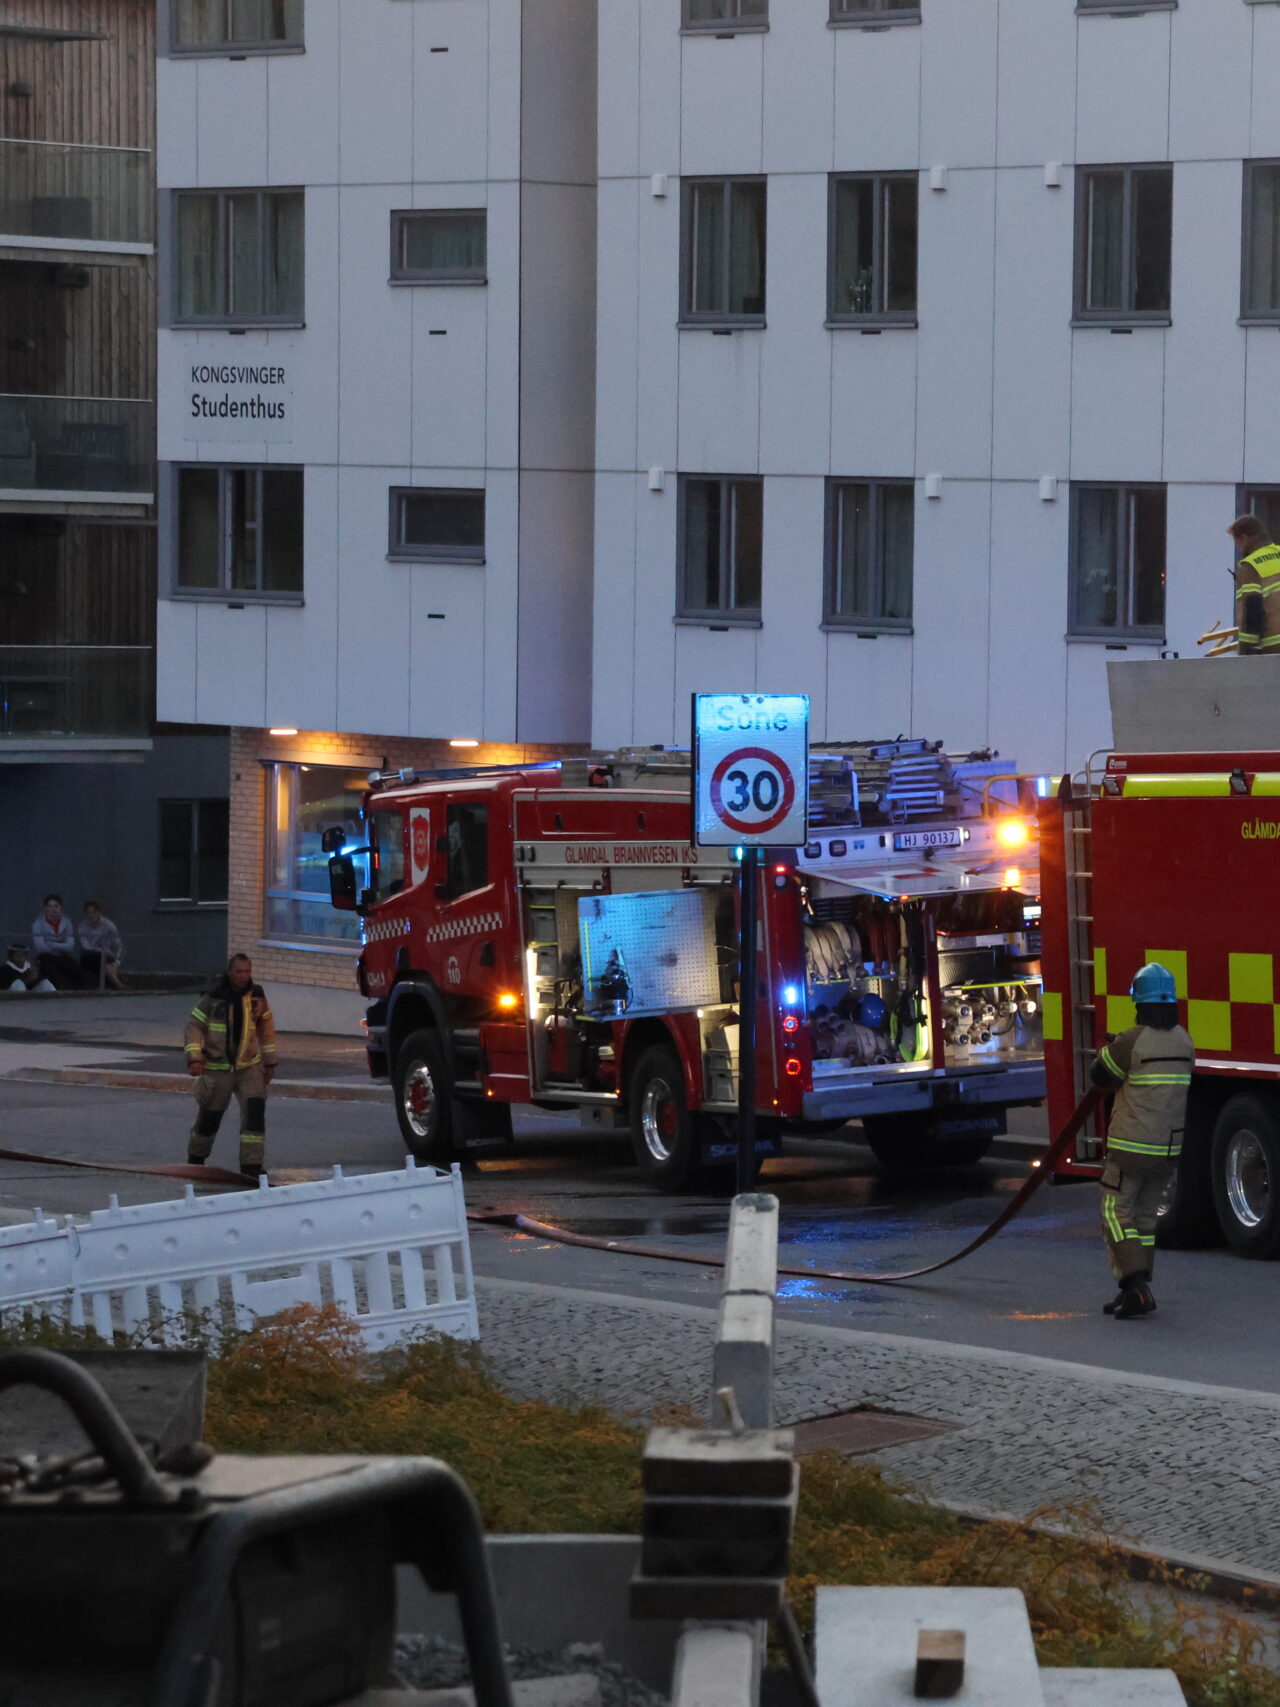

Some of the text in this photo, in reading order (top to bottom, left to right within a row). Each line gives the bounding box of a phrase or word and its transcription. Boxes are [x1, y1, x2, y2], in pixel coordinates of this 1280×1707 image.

[191, 366, 285, 384] KONGSVINGER
[191, 393, 285, 419] Studenthus
[717, 705, 788, 731] Sone
[727, 770, 779, 812] 30
[904, 831, 955, 847] HJ 90137
[613, 846, 678, 864] BRANNVESEN
[681, 846, 698, 864] IKS
[447, 968, 461, 984] 110
